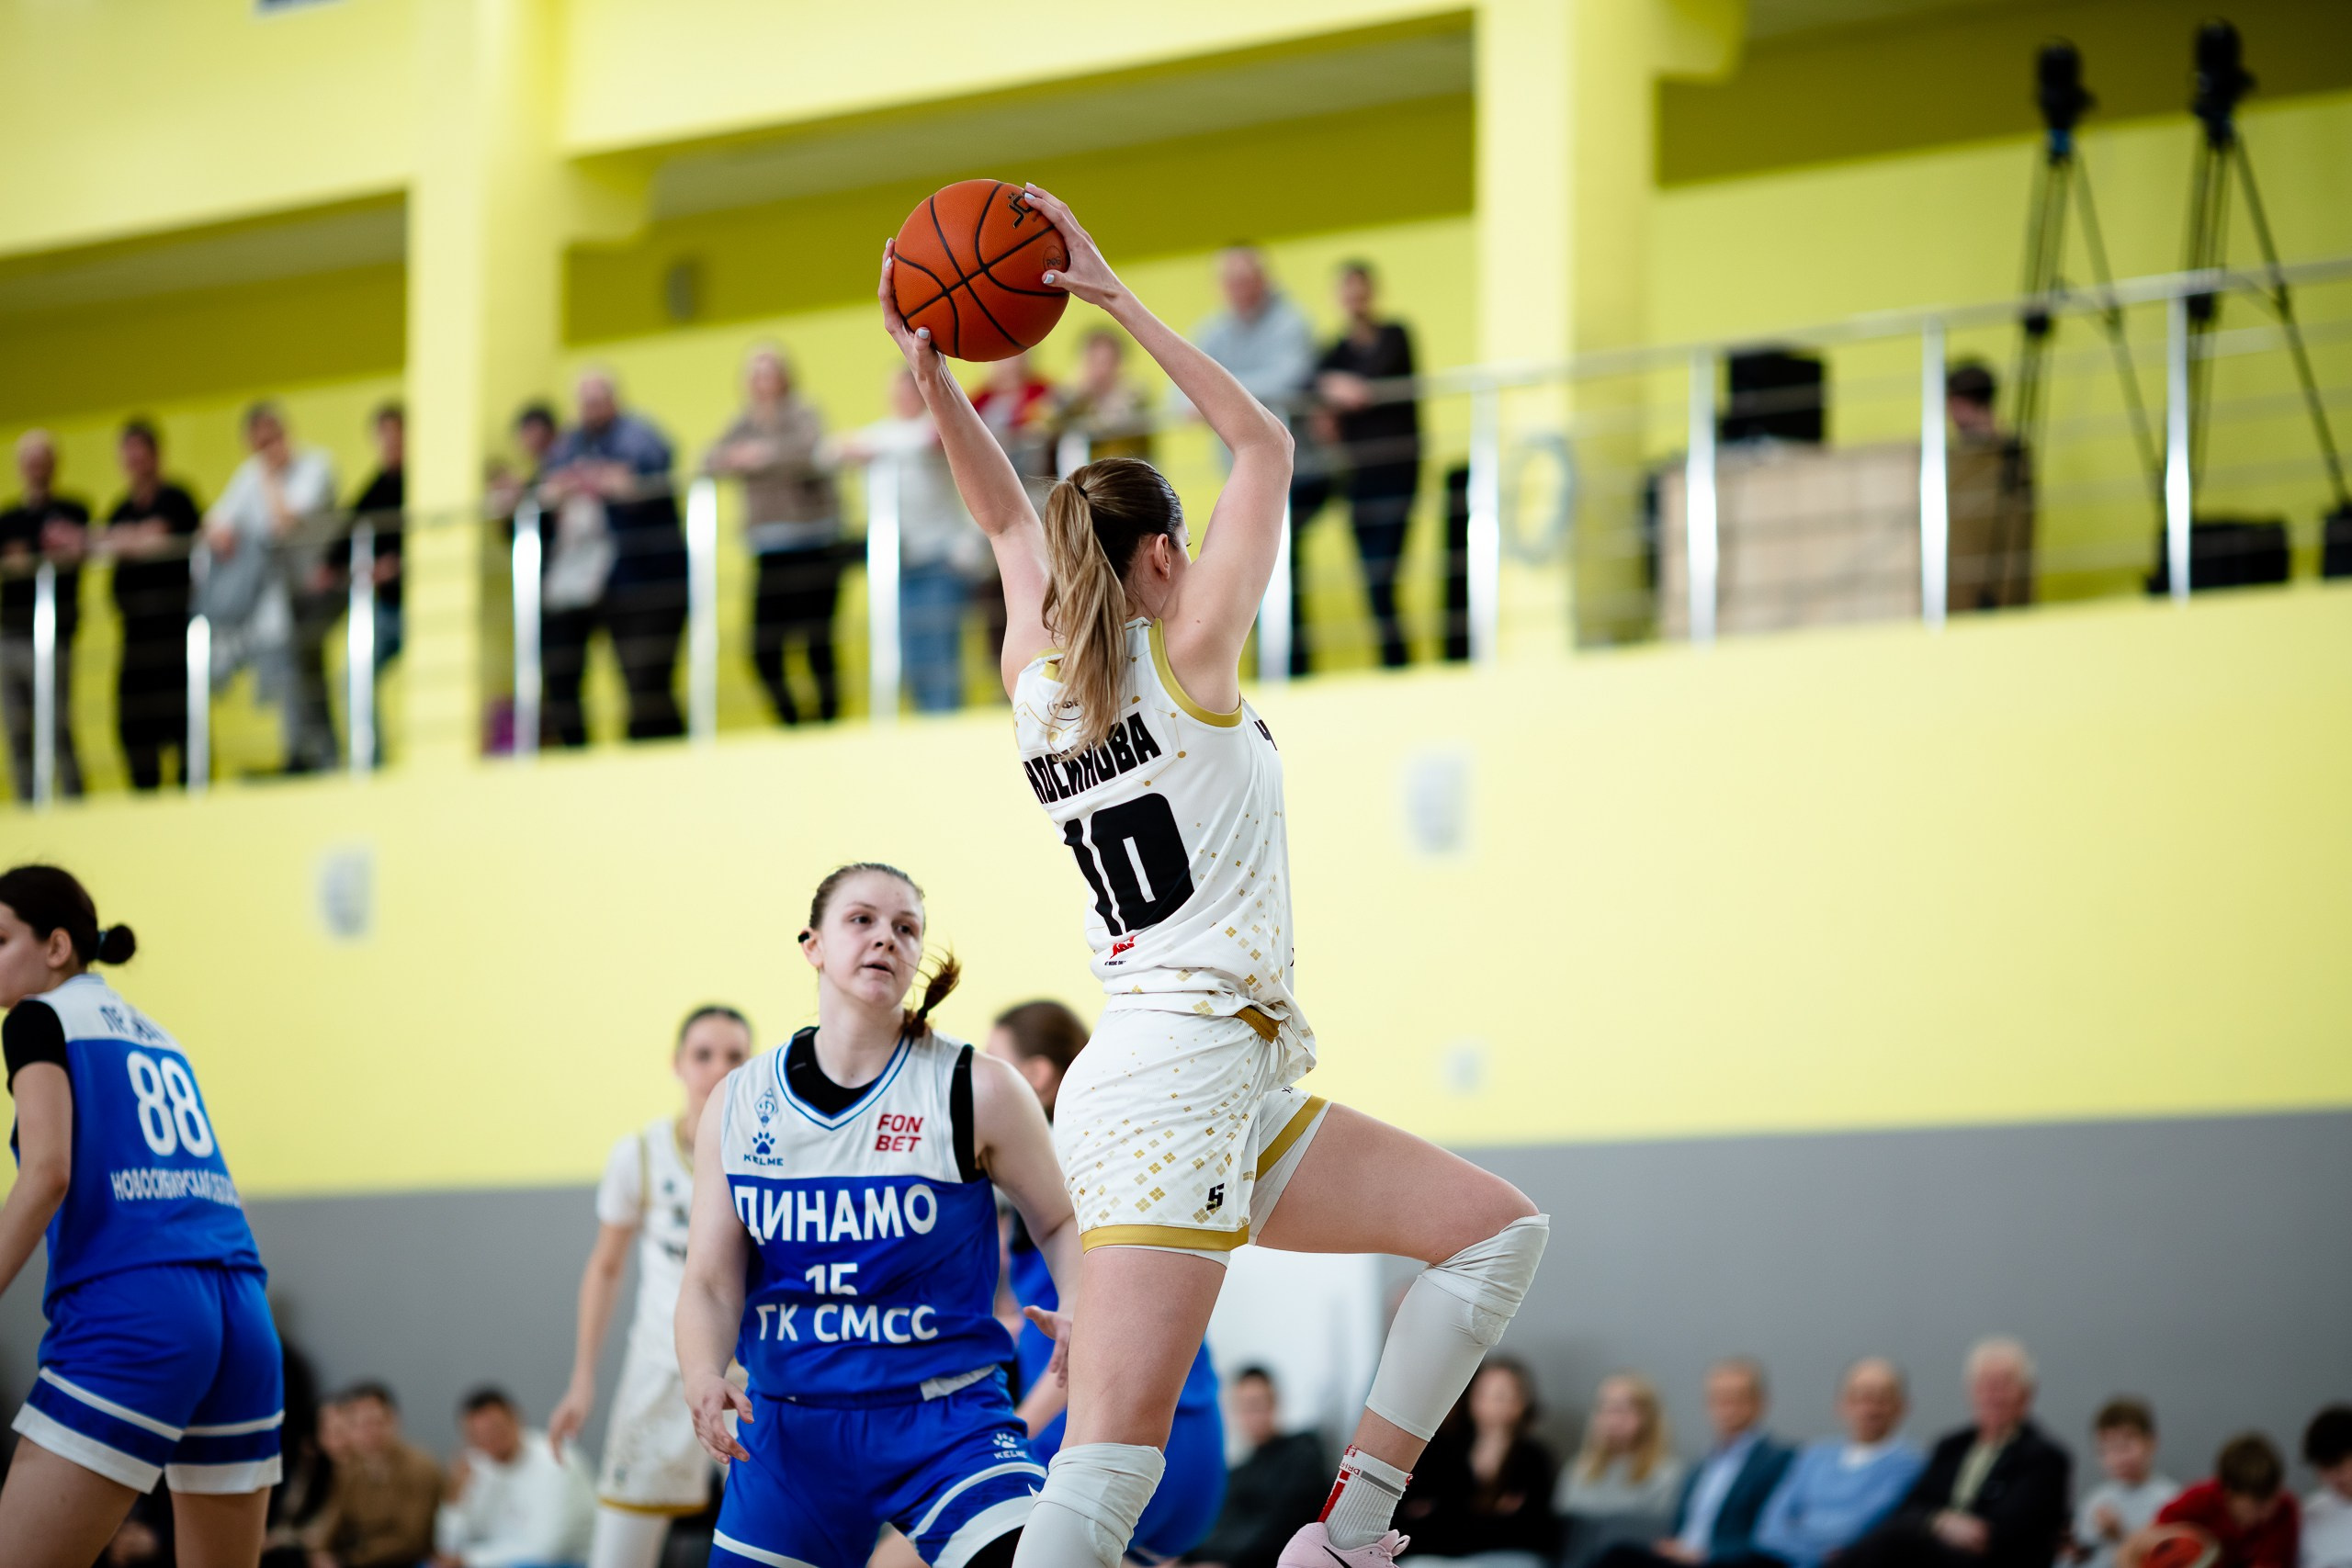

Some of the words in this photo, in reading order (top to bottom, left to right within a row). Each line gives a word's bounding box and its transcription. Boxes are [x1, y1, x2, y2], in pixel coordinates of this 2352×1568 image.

[1064, 793, 1195, 937] 10
[127, 1051, 214, 1157] 88
[877, 1113, 924, 1134] FON
[743, 1154, 784, 1167] KELME
[875, 1134, 922, 1154] BET
[734, 1183, 938, 1246] ДИНАМО
[805, 1262, 858, 1296] 15
[755, 1303, 799, 1342] ГК
[814, 1303, 939, 1344] СМСС
